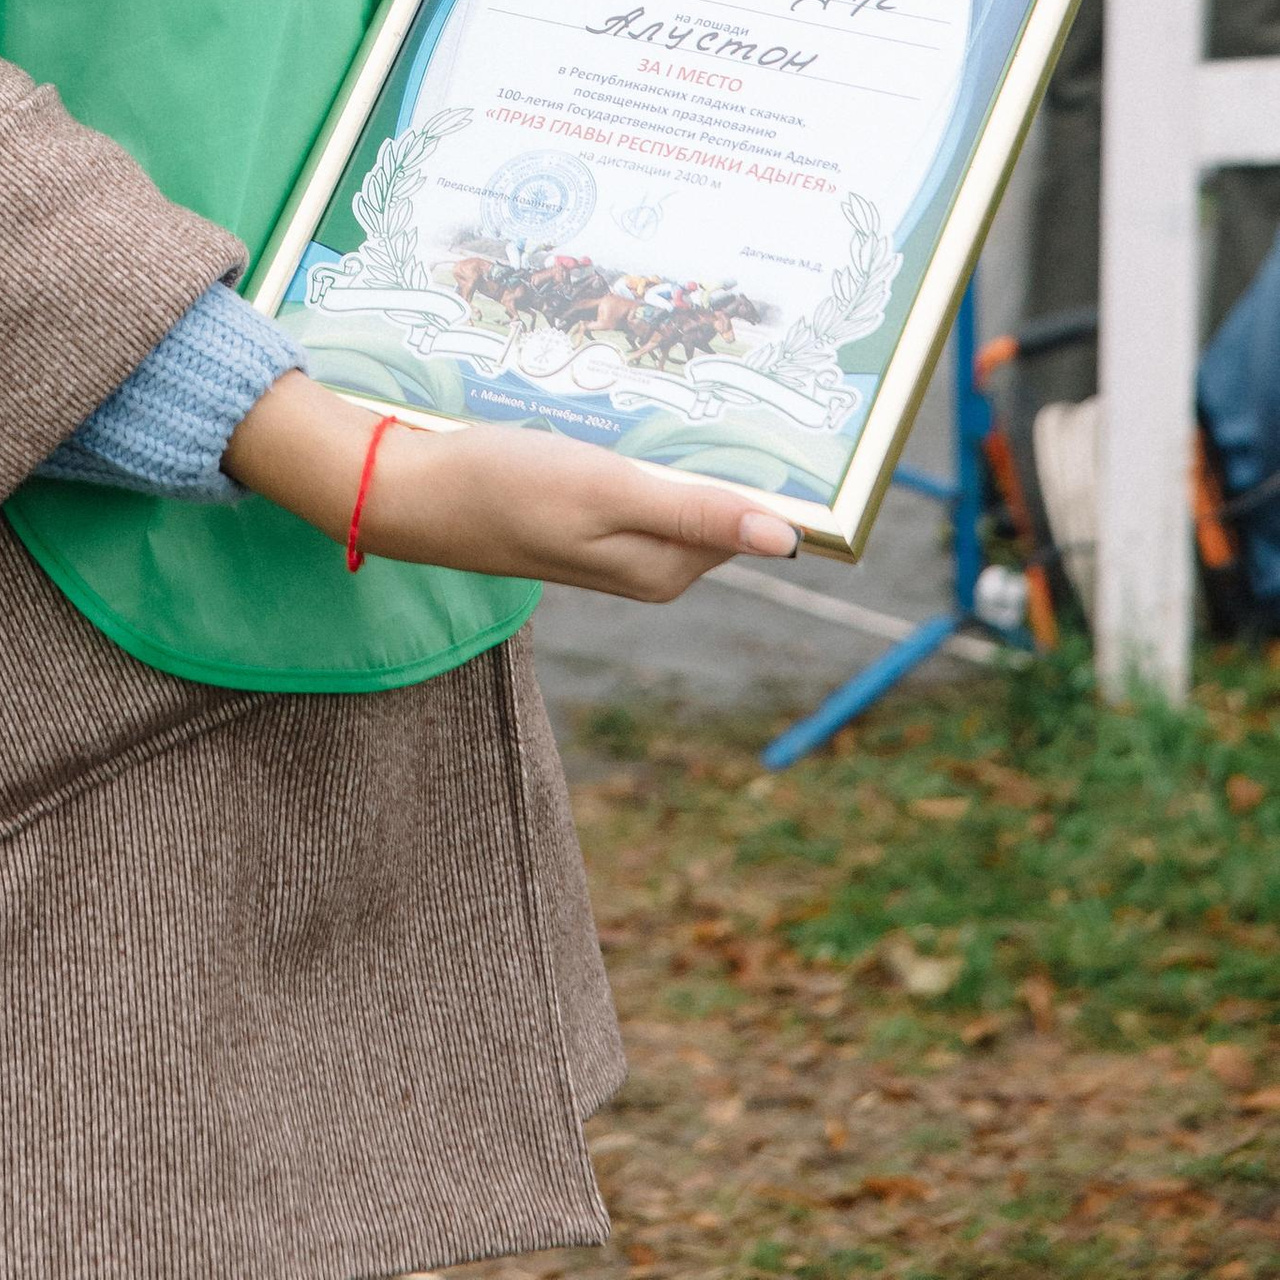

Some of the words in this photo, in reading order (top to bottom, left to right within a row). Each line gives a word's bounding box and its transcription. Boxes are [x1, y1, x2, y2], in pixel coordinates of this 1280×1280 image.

[674, 13, 691, 25] на
[694, 17, 750, 38] лошади
[636, 58, 660, 76] ЗА
[676, 65, 743, 92] МЕСТО
[558, 66, 566, 76] в
[570, 66, 688, 102] Республиканских
[690, 93, 746, 114] гладких
[750, 107, 806, 128] скачках,
[573, 88, 670, 116] посвященных
[672, 108, 777, 139] празднованию
[486, 107, 546, 130] «ПРИЗ
[549, 119, 614, 145] ГЛАВЫ
[617, 134, 744, 174] РЕСПУБЛИКИ
[746, 163, 837, 194] АДЫГЕЯ»
[496, 88, 564, 110] 100-летия
[567, 102, 696, 140] Государственности
[700, 131, 782, 159] Республики
[786, 150, 842, 174] Адыгея,
[578, 150, 595, 162] на
[598, 154, 672, 179] дистанции
[674, 170, 708, 187] 2400
[710, 180, 722, 189] м
[436, 177, 510, 202] Председатель
[512, 194, 563, 213] Комитета
[480, 390, 528, 410] Майкоп,
[528, 402, 537, 412] 5
[538, 405, 583, 424] октября
[584, 414, 612, 432] 2022
